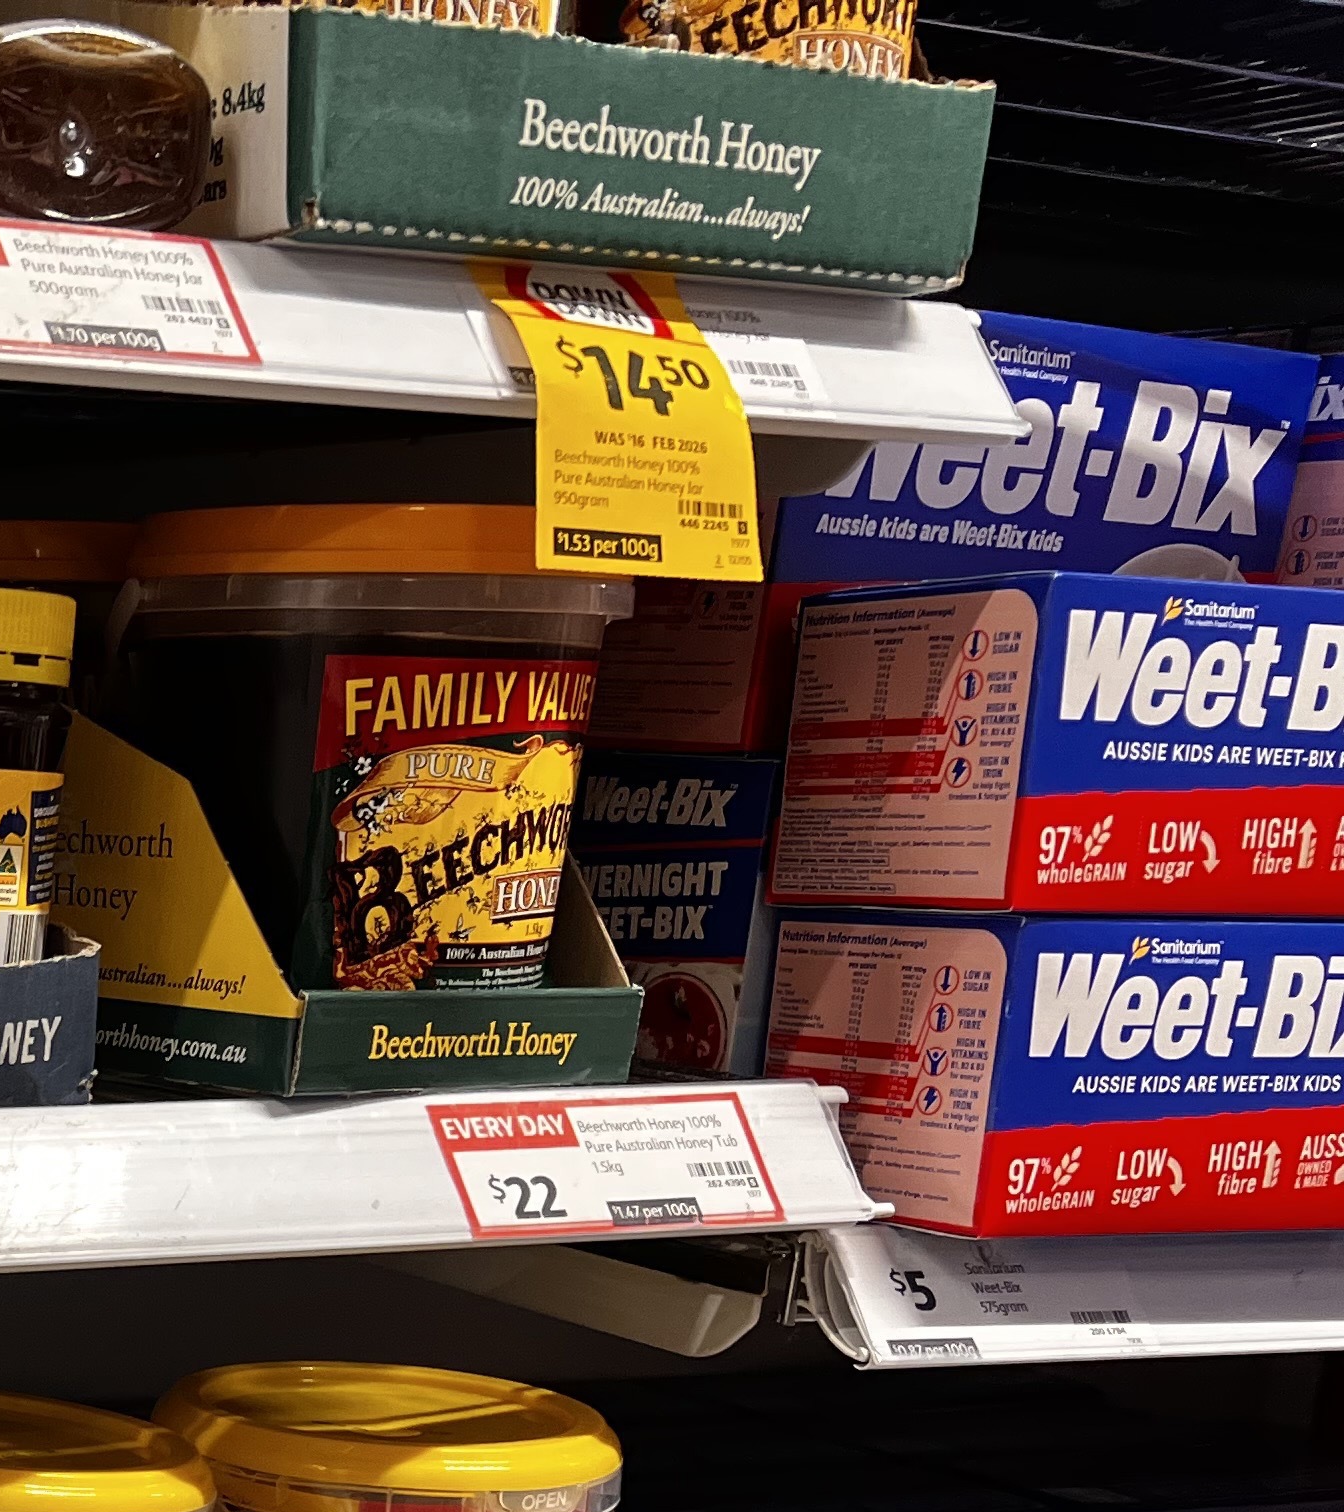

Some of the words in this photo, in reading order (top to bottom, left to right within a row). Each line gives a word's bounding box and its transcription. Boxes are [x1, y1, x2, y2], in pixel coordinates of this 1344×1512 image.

[519, 98, 712, 168] Beechworth
[716, 121, 822, 192] Honey
[510, 175, 580, 211] 100%
[989, 338, 1071, 371] Sanitarium
[594, 430, 626, 447] WAS
[652, 439, 675, 450] FEB
[557, 532, 591, 553] $1.53
[593, 537, 619, 558] per
[620, 537, 659, 561] 100g
[816, 512, 875, 538] Aussie
[878, 516, 918, 542] kids
[919, 519, 949, 543] are
[951, 519, 1027, 549] Weet-Bix
[1028, 528, 1064, 553] kids
[344, 670, 519, 736] FAMILY
[407, 751, 496, 785] PURE
[368, 1022, 504, 1062] Beechworth
[503, 1025, 577, 1065] Honey
[1071, 1075, 1137, 1094] AUSSIE
[1141, 1076, 1181, 1093] KIDS
[1184, 1075, 1219, 1093] ARE
[1223, 1075, 1300, 1092] WEET-BIX
[1303, 1075, 1342, 1092] KIDS
[440, 1117, 513, 1140] EVERY
[521, 1114, 564, 1137] DAY
[1116, 1149, 1167, 1182] LOW
[1208, 1140, 1263, 1172] HIGH
[488, 1173, 568, 1220] $22
[1111, 1183, 1160, 1208] sugar
[1217, 1171, 1257, 1197] fibre
[1005, 1188, 1095, 1215] wholeGRAIN
[521, 1490, 570, 1511] OPEN
